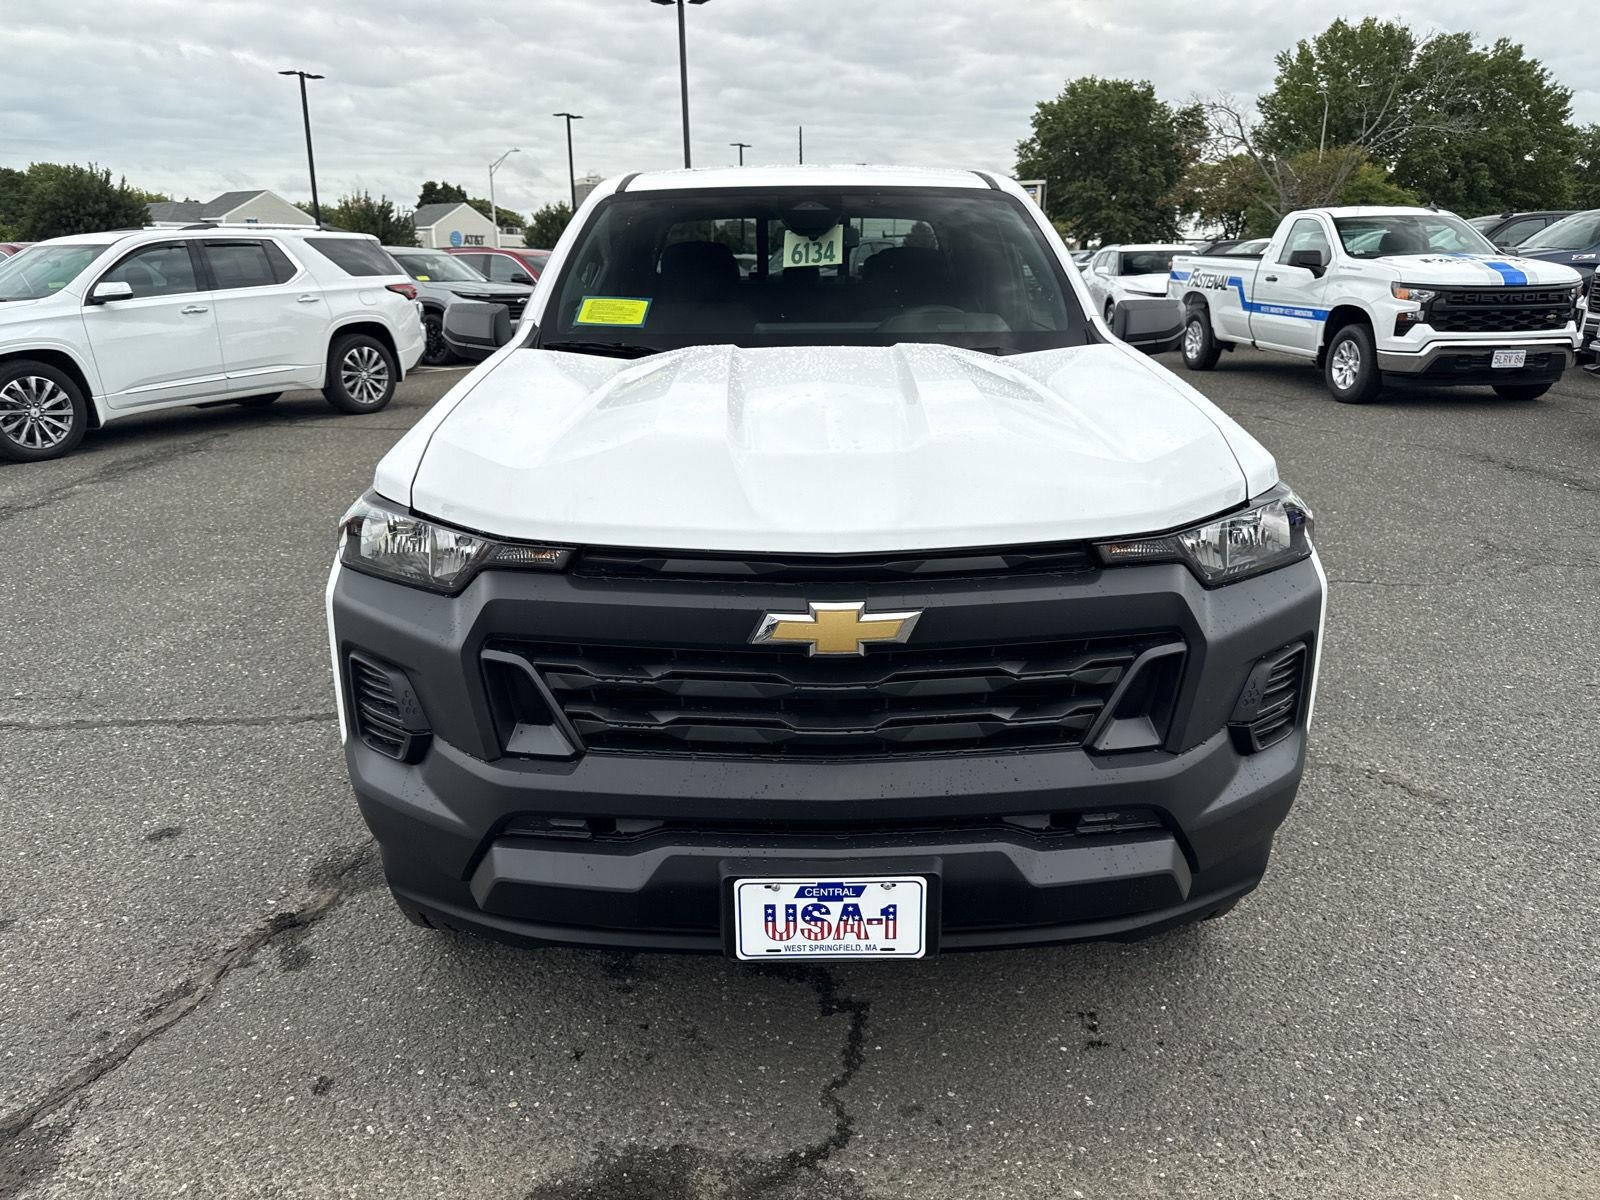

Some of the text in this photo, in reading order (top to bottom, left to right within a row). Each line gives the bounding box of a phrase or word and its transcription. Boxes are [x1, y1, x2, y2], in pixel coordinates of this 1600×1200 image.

[464, 235, 485, 245] AT&T
[791, 240, 836, 265] 6134
[804, 887, 856, 898] CENTRAL
[764, 903, 897, 941] USA-1
[784, 944, 878, 952] WEST SPRINGFIELD, MA
